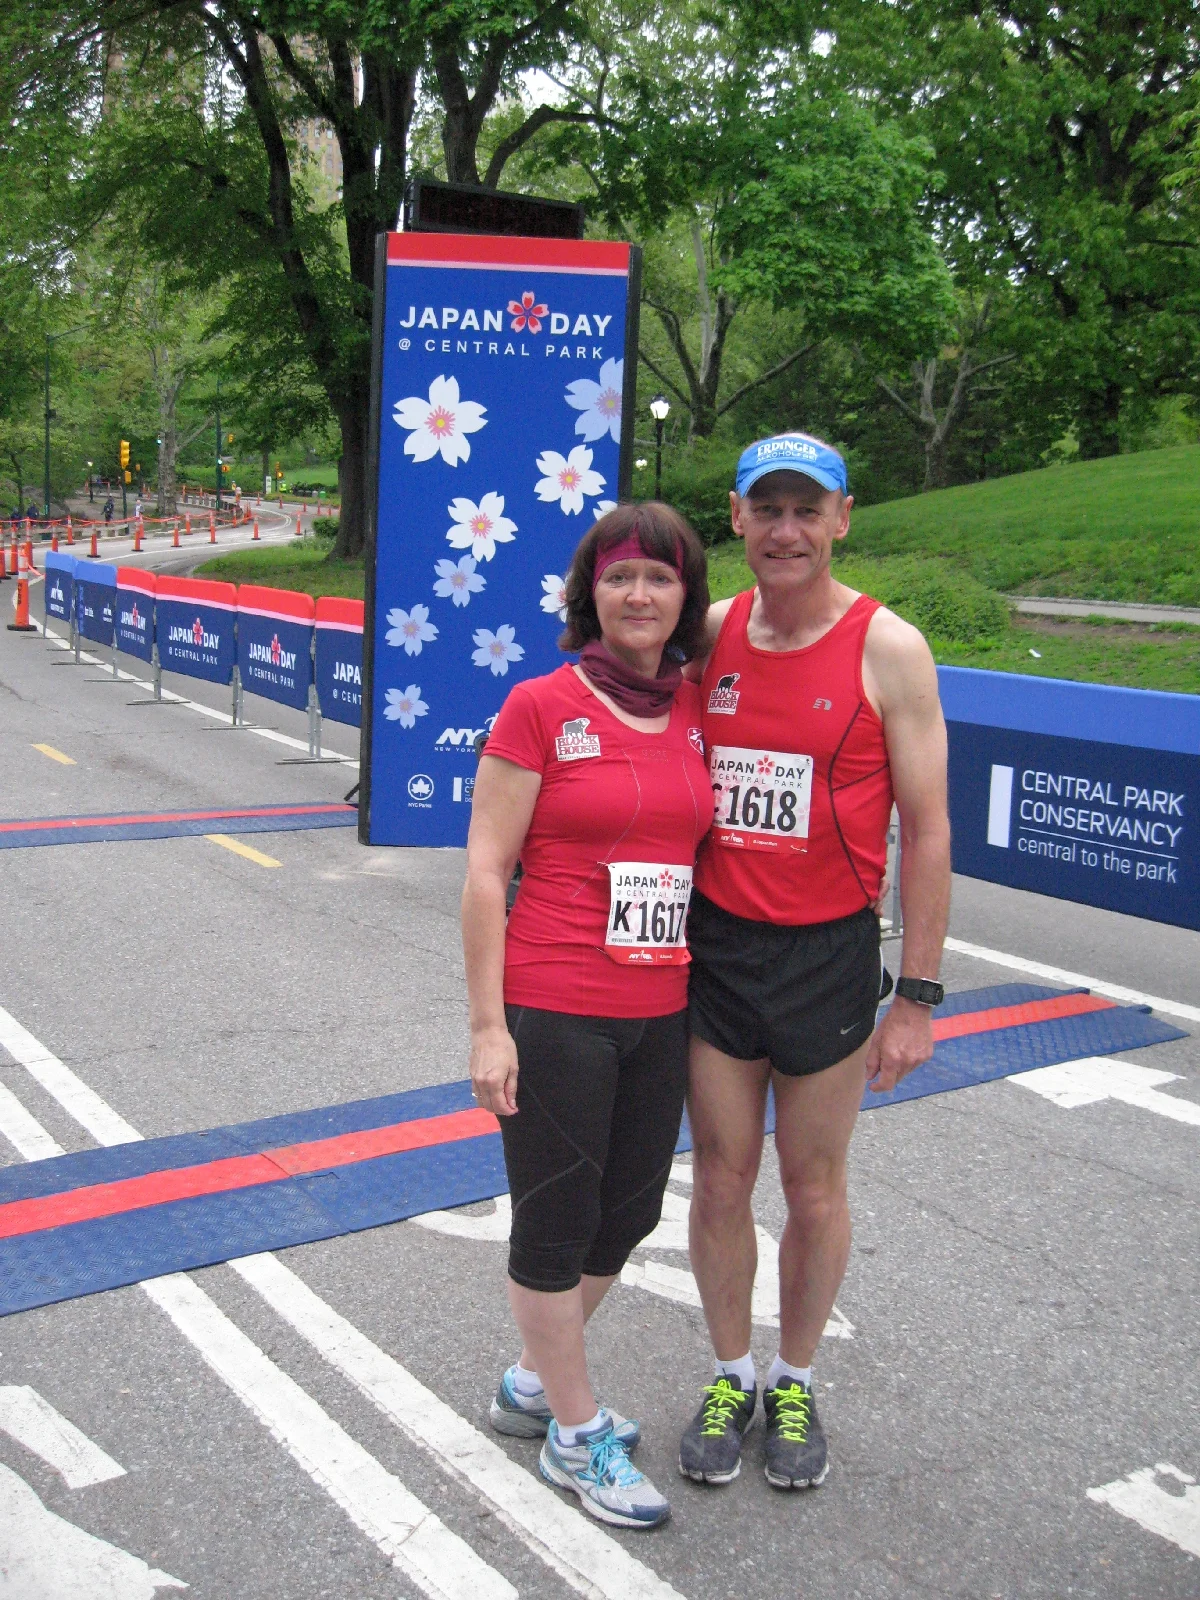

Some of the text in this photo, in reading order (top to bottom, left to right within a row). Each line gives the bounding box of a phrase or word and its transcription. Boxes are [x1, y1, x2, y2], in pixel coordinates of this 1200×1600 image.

[400, 306, 613, 337] JAPAN DAY
[398, 338, 603, 359] @ CENTRAL PARK
[757, 440, 816, 457] ERDINGER
[169, 625, 219, 650] JAPAN DAY
[174, 648, 200, 662] CENTRAL
[202, 653, 218, 665] PARK
[249, 643, 296, 670] JAPAN DAY
[254, 667, 278, 684] CENTRAL
[280, 675, 295, 689] PARK
[333, 661, 363, 685] JAPA
[709, 699, 737, 709] HOUSE
[711, 691, 738, 700] BLOCK
[557, 736, 598, 747] BLOCK
[558, 745, 600, 755] HOUSE
[711, 759, 805, 779] JAPAN DAY
[719, 773, 766, 784] CENTRAL
[774, 779, 803, 788] PARK
[1021, 769, 1185, 817] CENTRAL PARK
[725, 785, 797, 832] 1618
[1020, 799, 1183, 848] CONSERVANCY
[1017, 837, 1177, 884] central to the park
[616, 875, 690, 890] JAPAN DAY
[627, 889, 668, 898] CENTRAL
[613, 900, 632, 932] K
[637, 900, 685, 943] 1617
